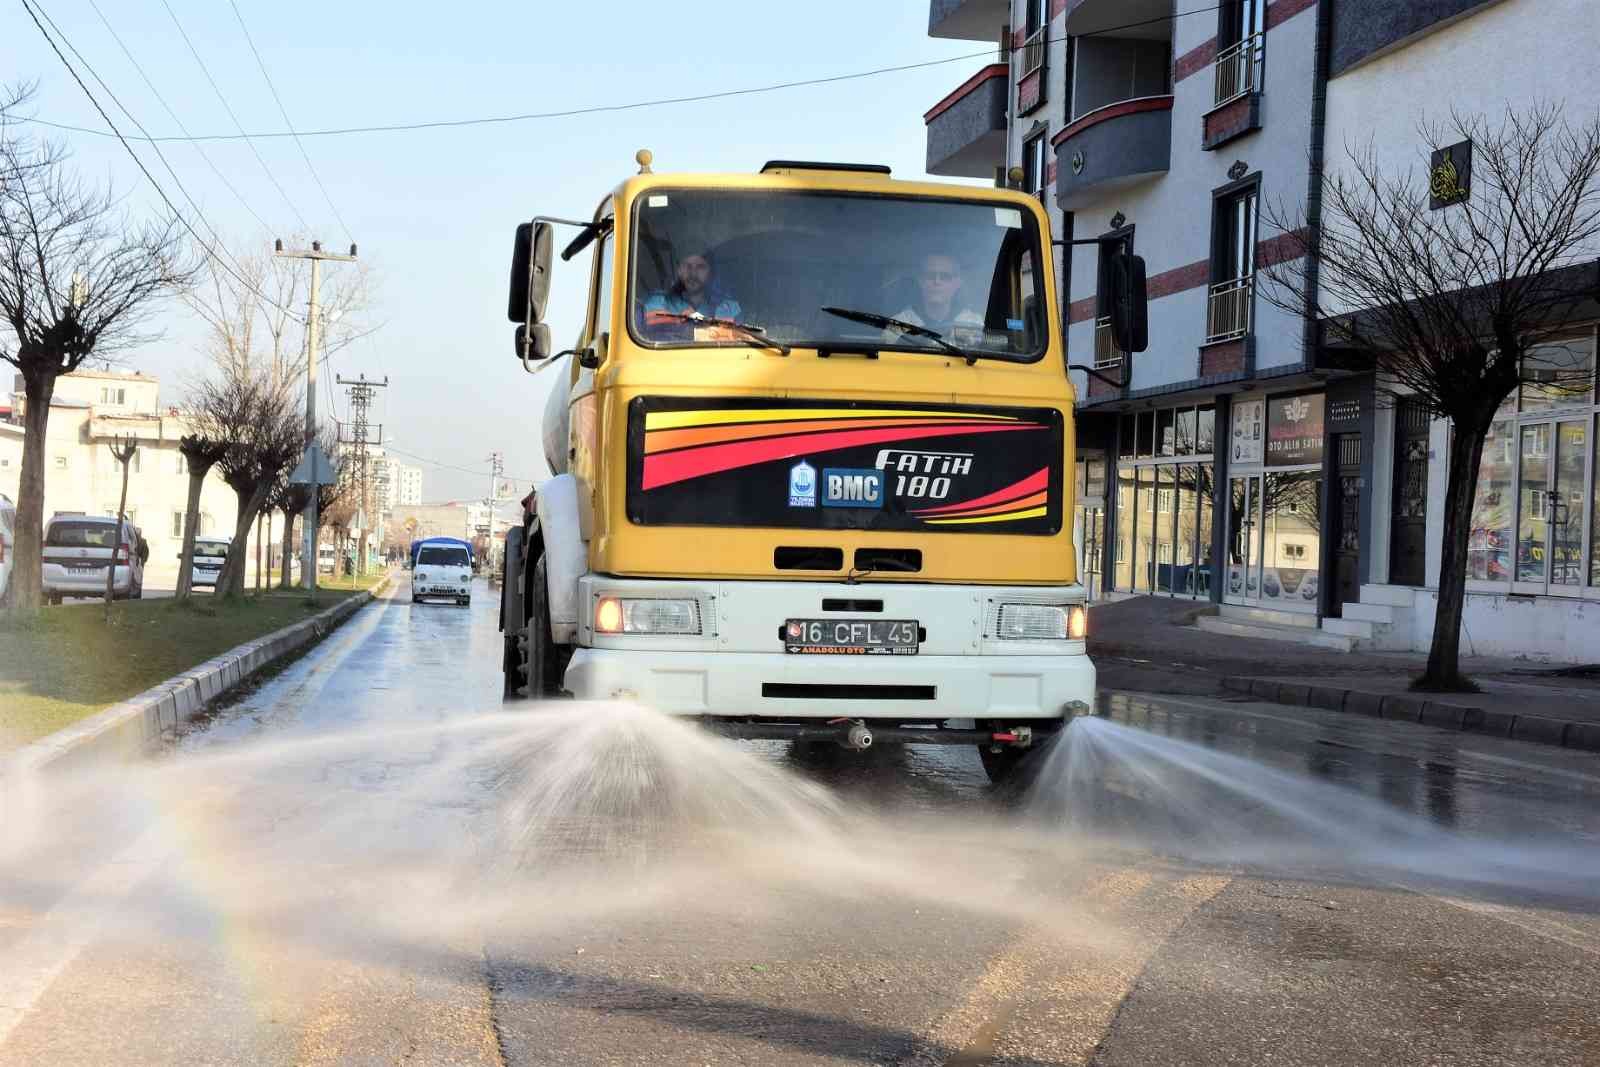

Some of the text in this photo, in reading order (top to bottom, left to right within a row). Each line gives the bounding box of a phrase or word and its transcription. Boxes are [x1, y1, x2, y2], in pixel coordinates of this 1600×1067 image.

[828, 475, 879, 501] BMC
[895, 475, 950, 499] 180
[800, 622, 913, 643] 16 CFL 45
